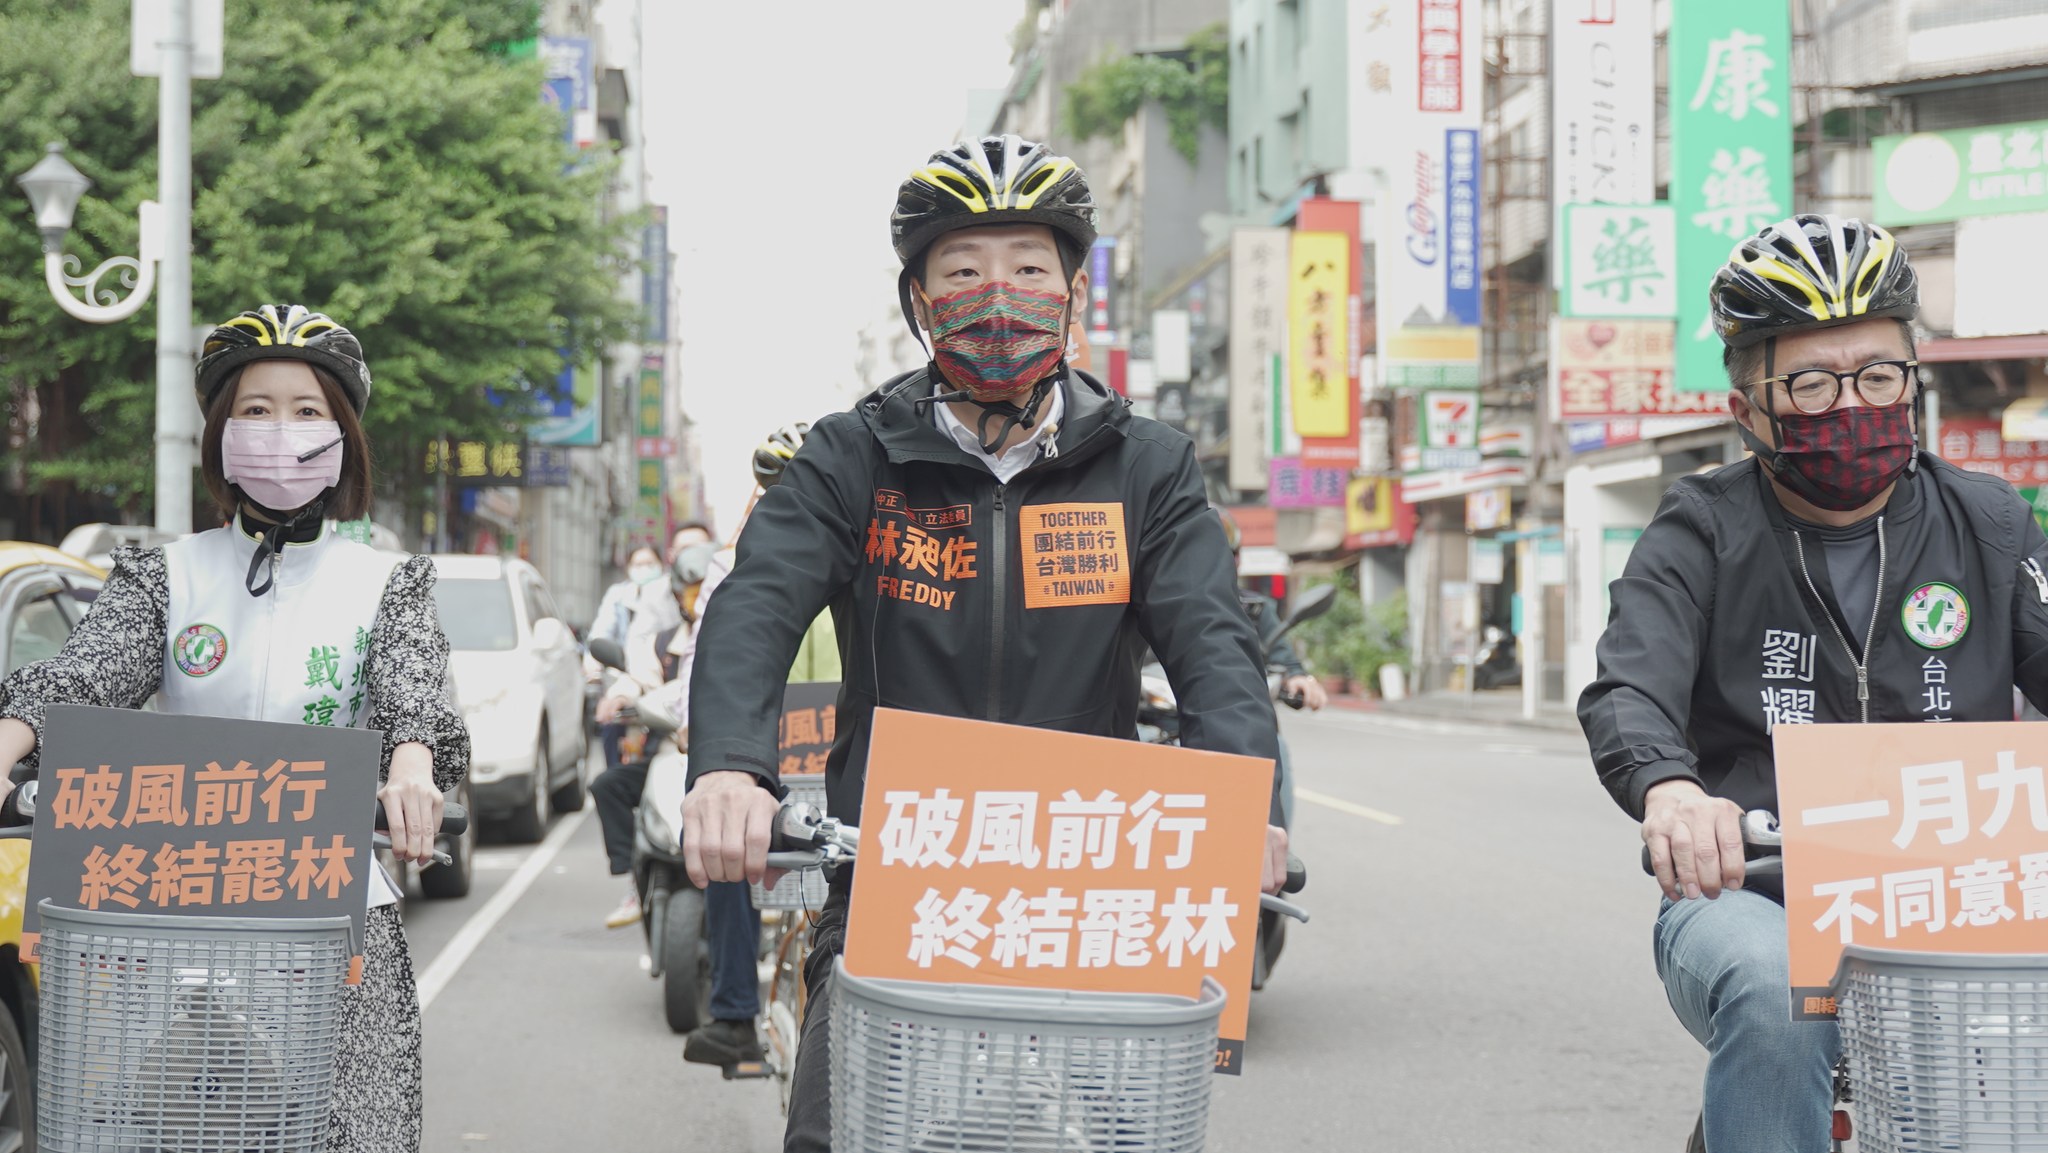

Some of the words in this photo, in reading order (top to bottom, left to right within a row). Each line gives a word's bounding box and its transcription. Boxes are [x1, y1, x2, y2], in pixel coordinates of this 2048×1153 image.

[1583, 216, 1666, 303] 藥
[865, 518, 978, 582] 林昶佐
[1034, 529, 1117, 554] 團結前行
[1040, 511, 1107, 529] TOGETHER
[878, 575, 957, 611] FREDDY
[1036, 553, 1119, 578] 台灣勝利
[1052, 579, 1105, 597] TAIWAN
[1761, 628, 1817, 734] 劉耀
[1921, 656, 1953, 723] 台北
[51, 759, 326, 831] 破風前行
[878, 788, 1207, 870] 破風前行
[1801, 750, 2048, 850] 一月九
[79, 834, 356, 911] 終結罷林
[907, 886, 1239, 969] 終結罷林
